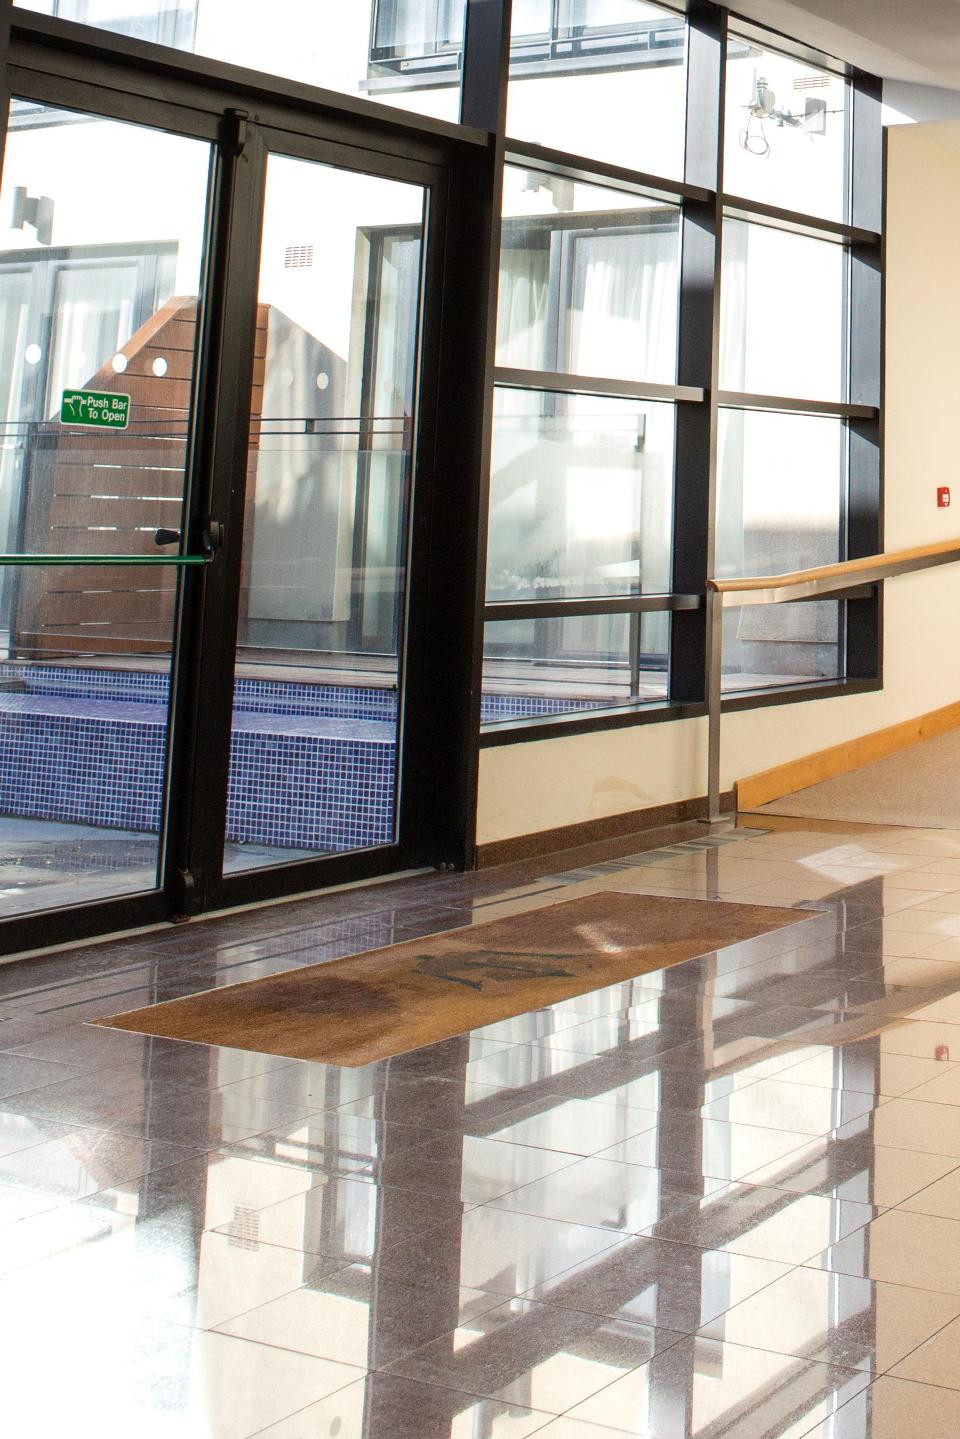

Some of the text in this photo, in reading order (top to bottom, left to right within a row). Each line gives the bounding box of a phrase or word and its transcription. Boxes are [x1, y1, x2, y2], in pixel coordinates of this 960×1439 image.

[87, 396, 127, 410] Push Bar
[87, 408, 125, 422] To Open
